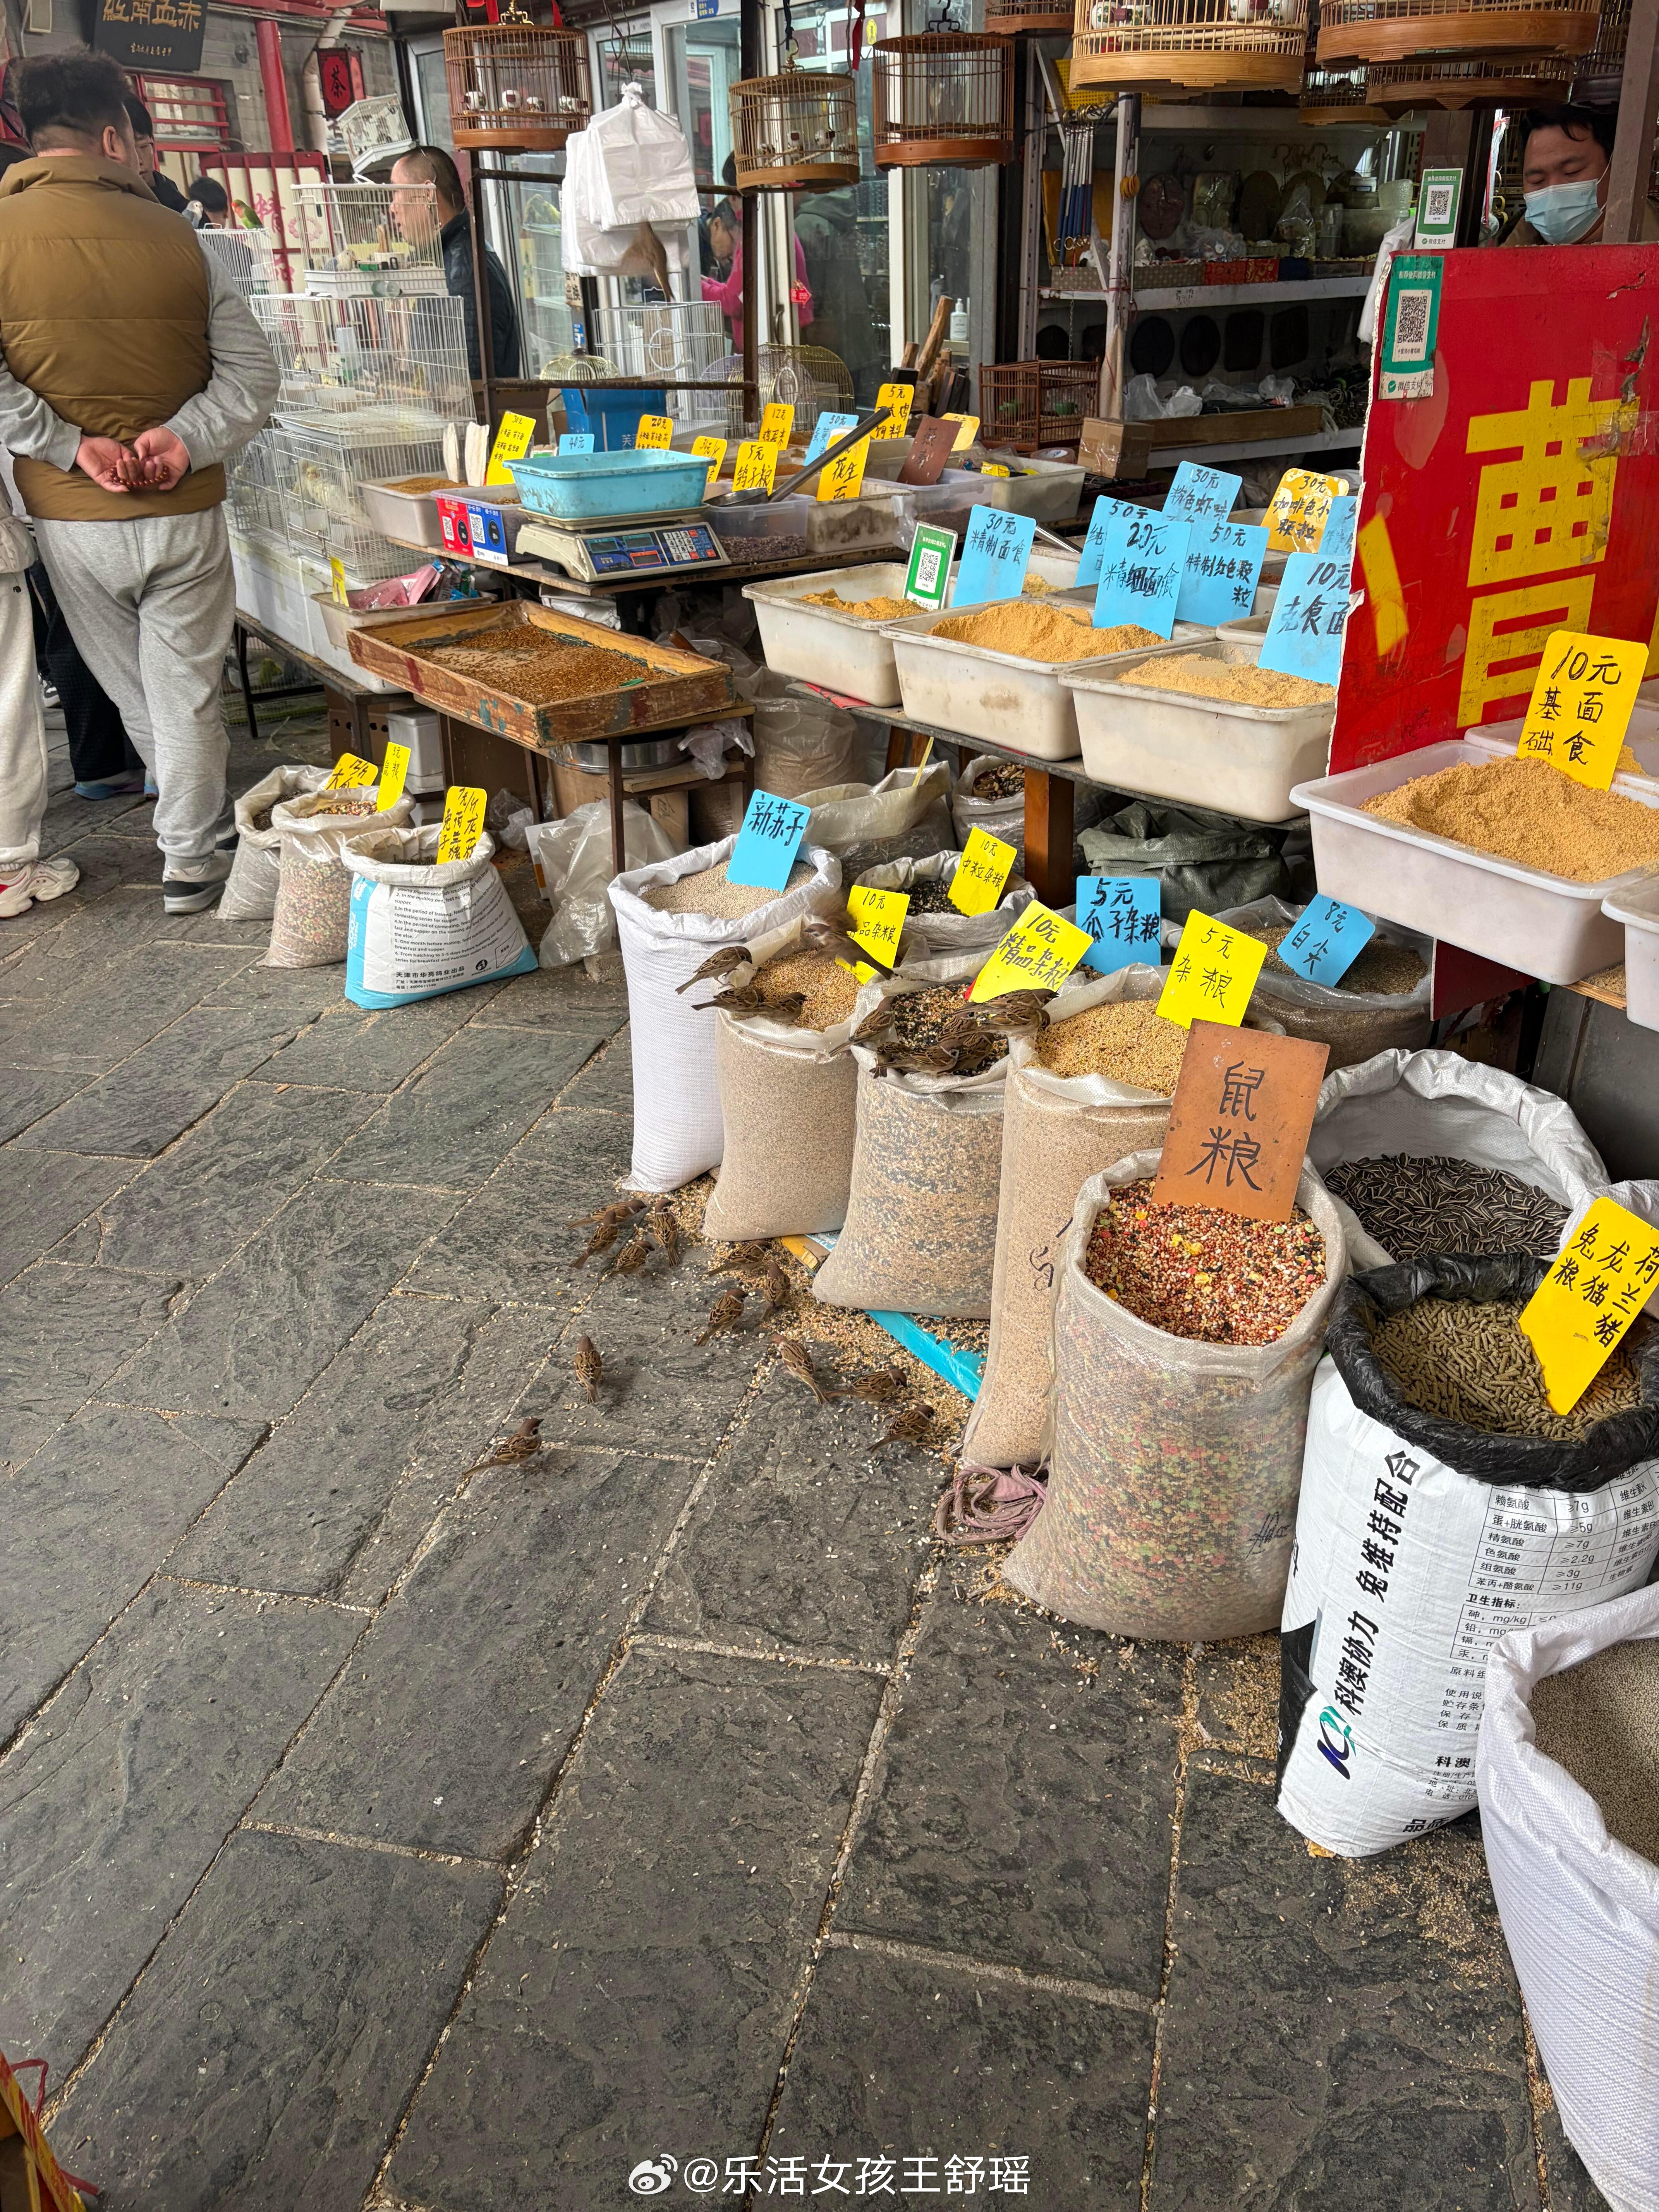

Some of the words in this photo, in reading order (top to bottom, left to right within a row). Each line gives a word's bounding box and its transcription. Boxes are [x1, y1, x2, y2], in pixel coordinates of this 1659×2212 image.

[888, 385, 905, 399] 5元
[1398, 381, 1422, 391] 微信支付
[651, 417, 667, 429] 20元
[747, 445, 764, 461] 5元
[737, 464, 773, 488] 鸽子粮
[1192, 469, 1220, 489] 30元
[1298, 476, 1327, 493] 30元
[1273, 496, 1330, 519] 咖啡色小
[986, 514, 1017, 534] 30元
[1209, 522, 1247, 547] 50元
[1275, 518, 1317, 540] 颗粒
[970, 530, 1027, 564] 精制面食
[1307, 562, 1350, 592] 10元
[1551, 644, 1621, 685] 10元
[747, 794, 805, 847] 新苏子
[979, 838, 997, 857] 10元
[962, 856, 1005, 893] 中粒杂粮
[862, 889, 886, 910] 10元
[1089, 878, 1133, 907] 5元
[1025, 913, 1060, 944] 10元
[1325, 900, 1345, 933] 8元
[1199, 926, 1232, 960] 5元
[396, 966, 465, 978] 天津市华亮鸽业出品
[1000, 932, 1070, 990] 精品杂粮
[1174, 955, 1234, 1010] 杂粮
[1184, 1060, 1266, 1192] 鼠粮
[1494, 1494, 1530, 1511] 赖氨酸
[1620, 1481, 1647, 1501] 维生素K
[1356, 1450, 1420, 1603] 兔维持配合
[1492, 1514, 1548, 1534] 蛋+胱氨酸
[1623, 1499, 1655, 1521] 维生素B1
[1487, 1532, 1525, 1547] 精氨酸
[1485, 1548, 1521, 1561] 色氨酸
[1476, 1577, 1535, 1591] 苯丙+酪氨酸
[1609, 1565, 1633, 1582] 生物素
[1480, 1562, 1517, 1575] 组氨酸
[1334, 1611, 1379, 1716] 科澳协力
[1440, 1710, 1482, 1720] 保存
[1442, 1699, 1485, 1711] 贮存条
[1435, 1756, 1476, 1768] 科澳
